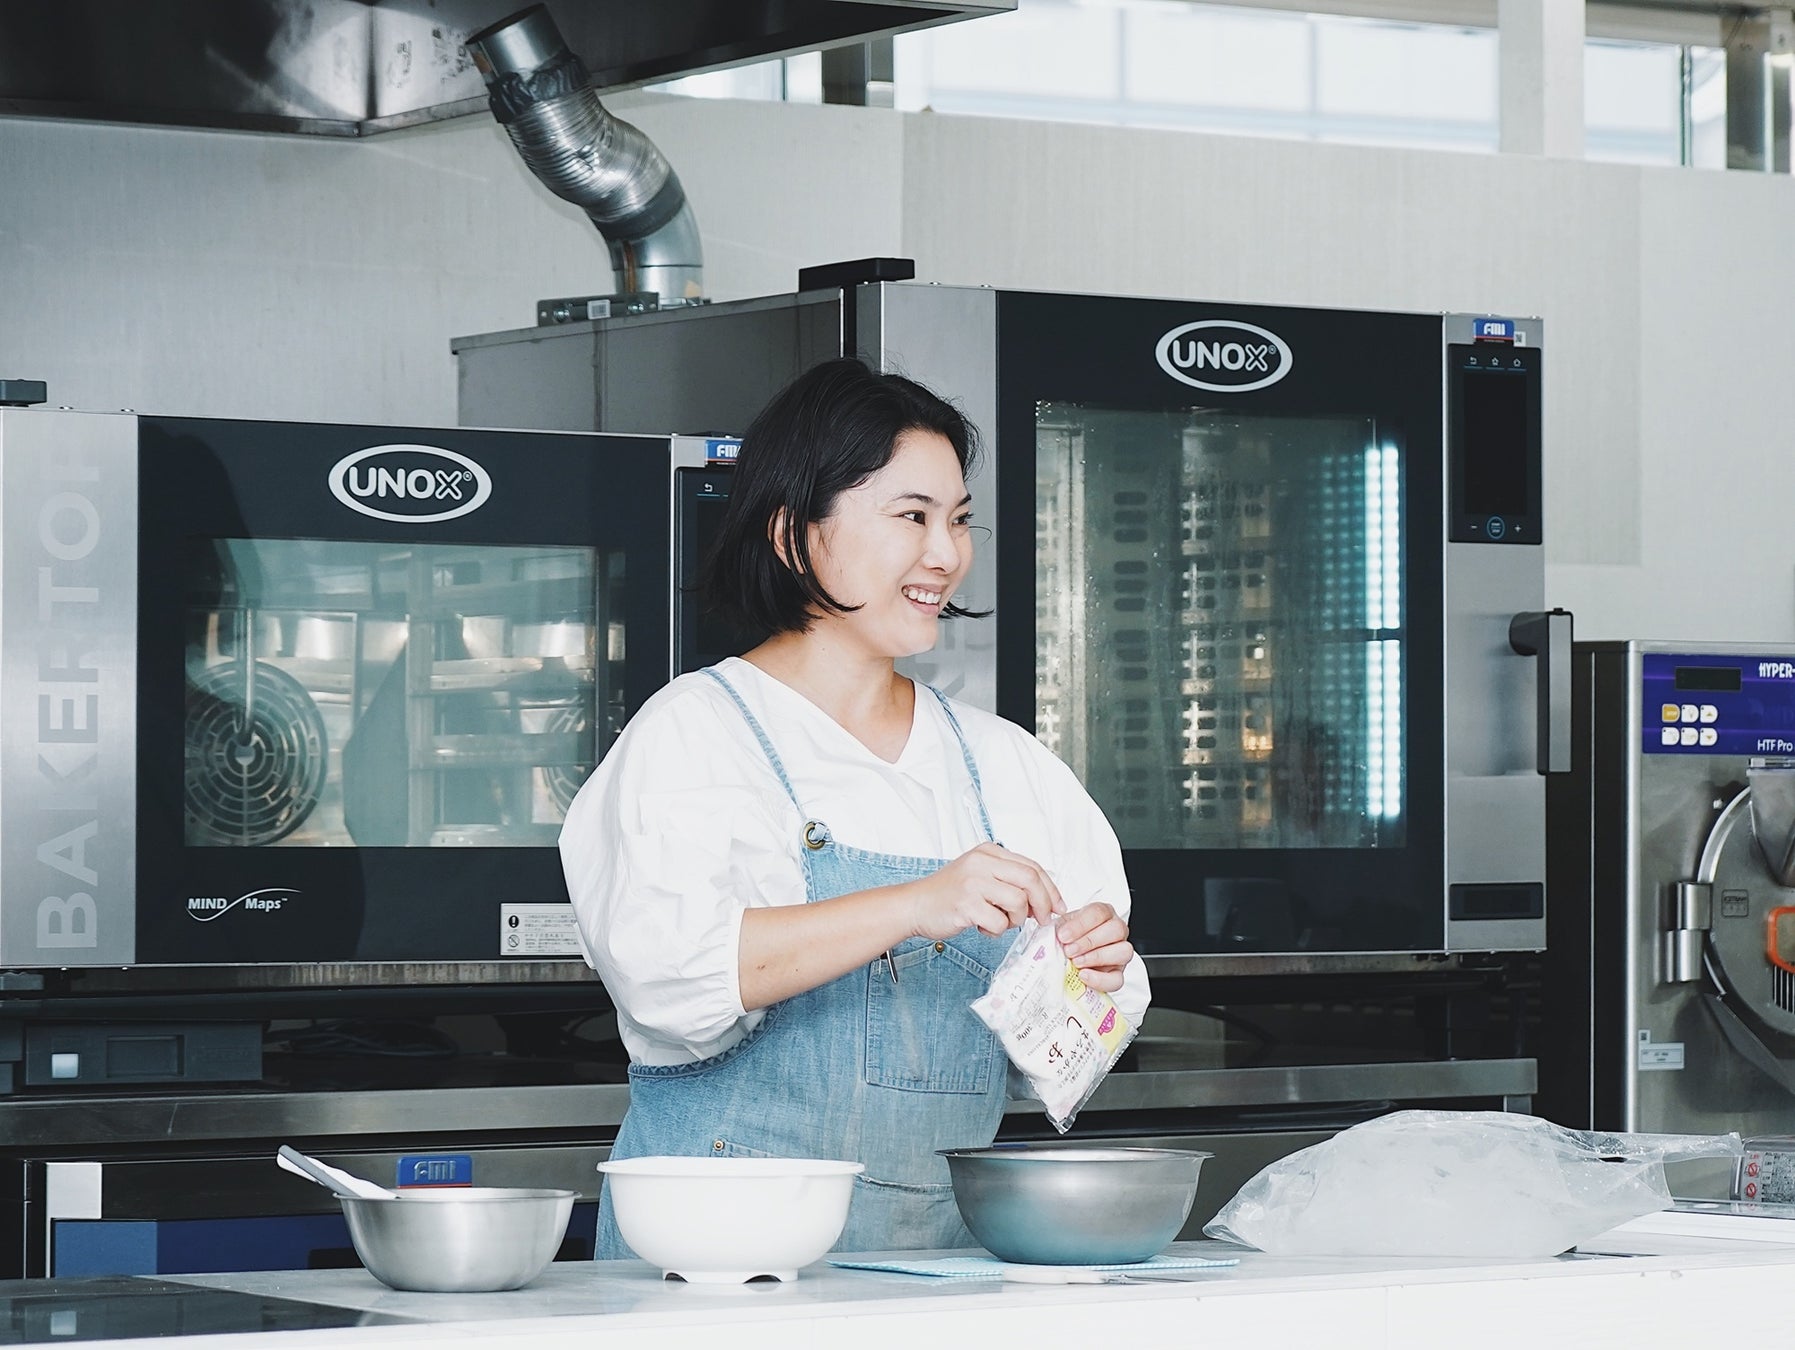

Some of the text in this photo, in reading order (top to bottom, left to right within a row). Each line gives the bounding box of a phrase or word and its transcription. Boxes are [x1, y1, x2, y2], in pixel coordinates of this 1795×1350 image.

[1172, 340, 1268, 372] UNOX
[348, 466, 463, 501] UNOX
[1757, 739, 1794, 753] HTF Pro
[188, 898, 282, 913] MIND Maps
[413, 1160, 457, 1181] FMI
